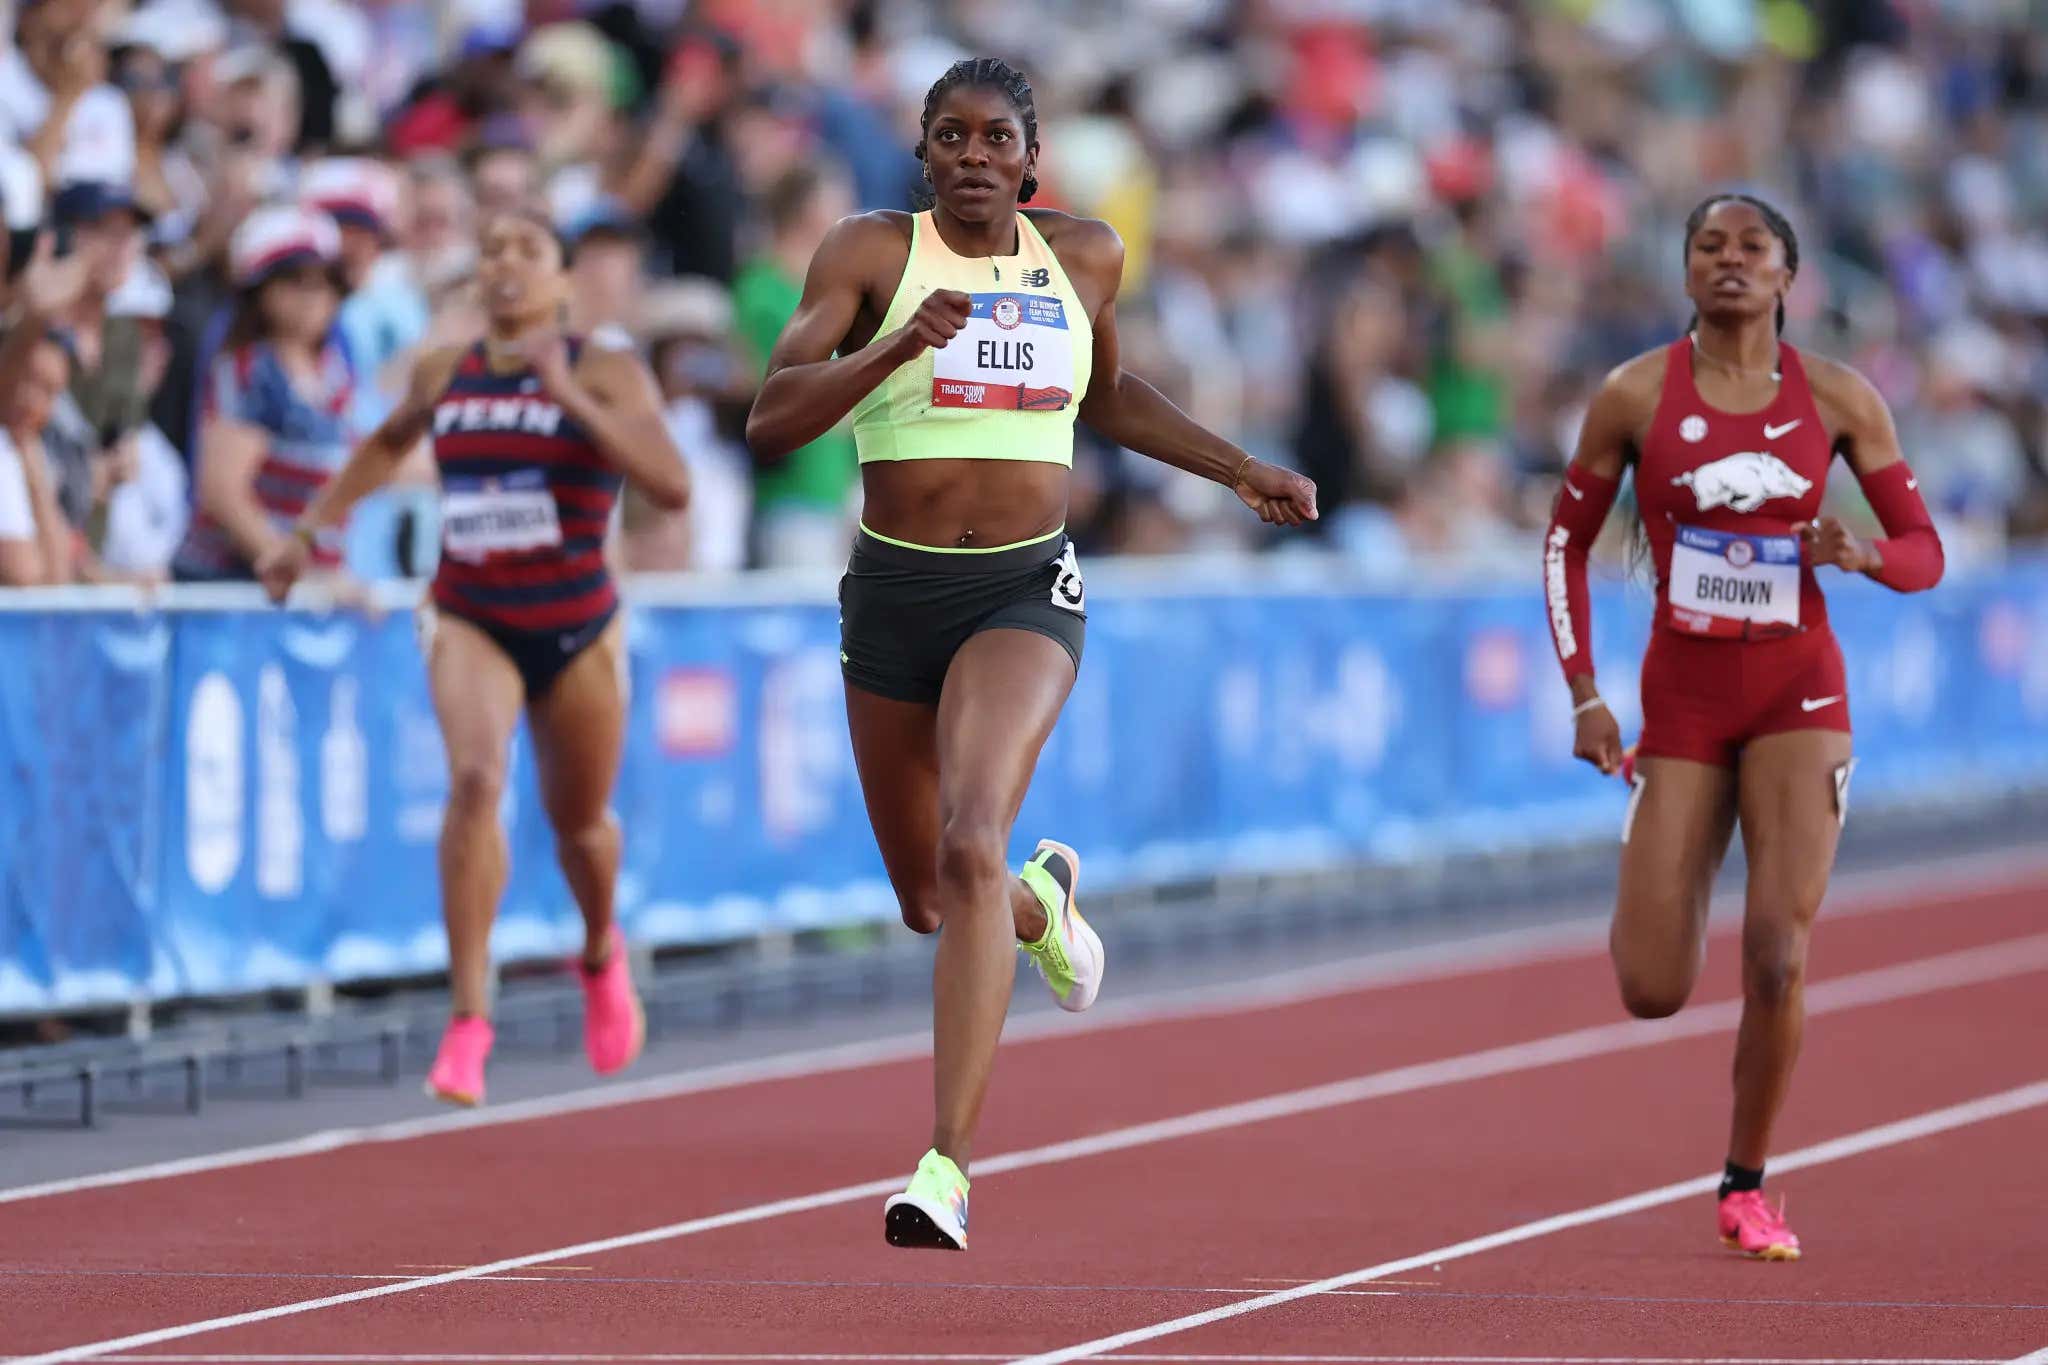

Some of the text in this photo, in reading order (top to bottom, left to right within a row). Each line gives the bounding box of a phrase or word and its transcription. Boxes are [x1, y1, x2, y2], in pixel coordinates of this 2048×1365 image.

[977, 340, 1034, 371] ELLIS
[963, 393, 983, 403] 2024
[1696, 573, 1773, 605] BROWN
